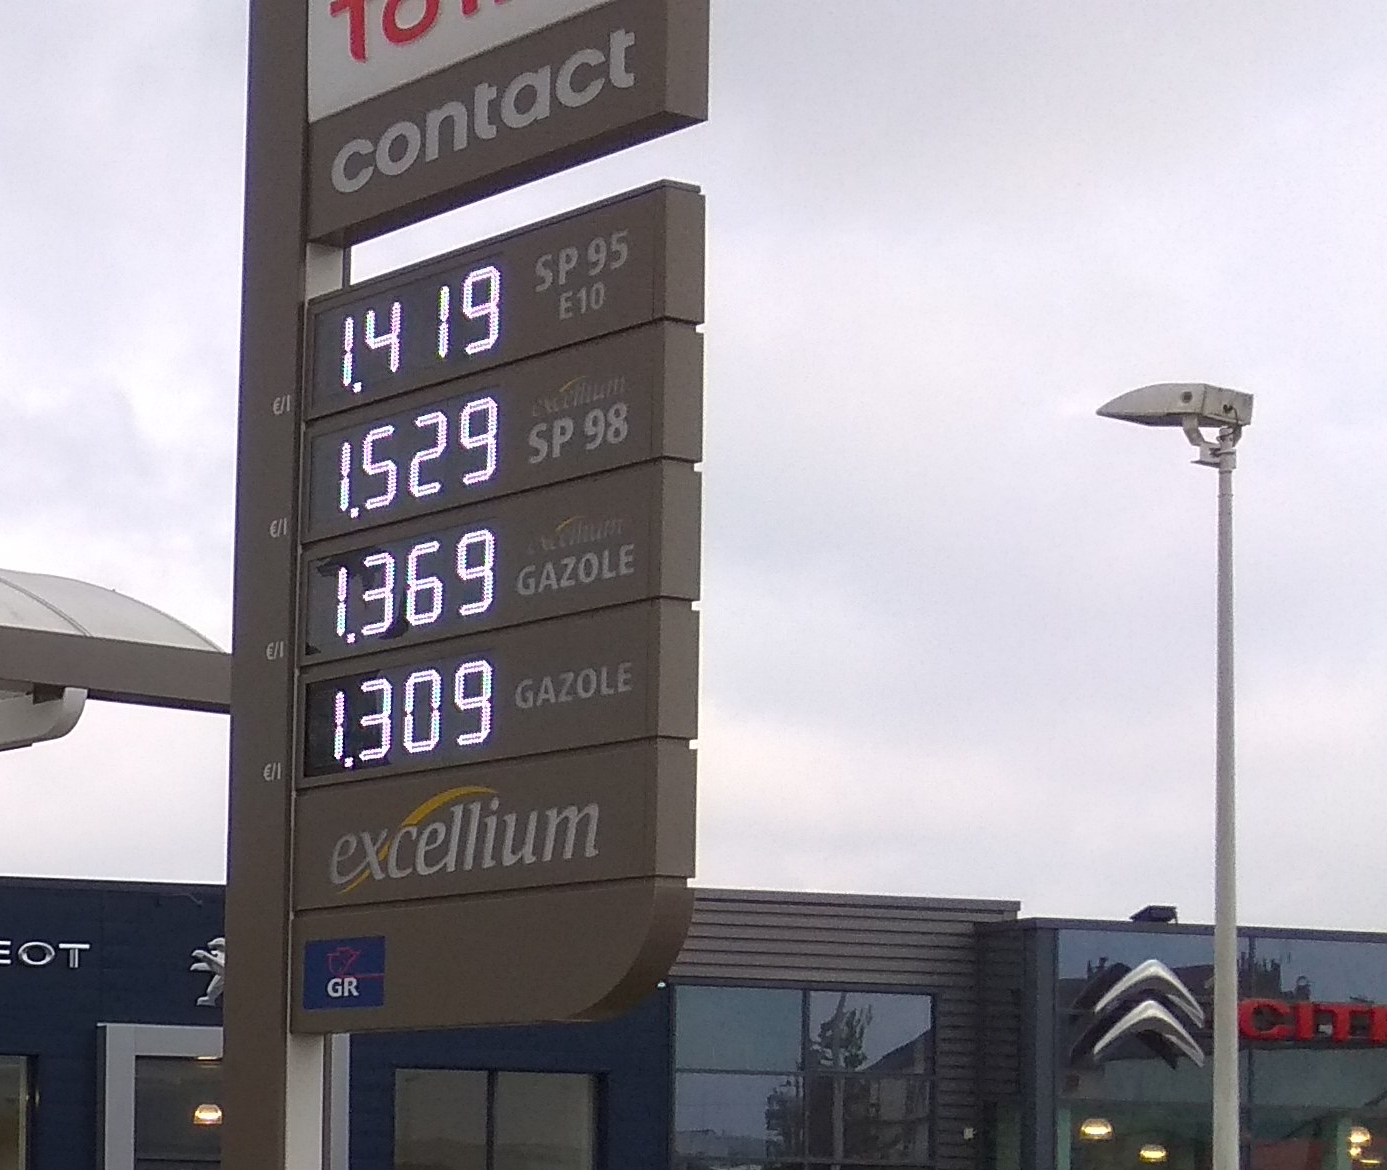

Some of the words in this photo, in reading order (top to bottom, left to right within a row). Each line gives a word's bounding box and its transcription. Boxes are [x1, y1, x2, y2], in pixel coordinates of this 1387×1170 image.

[331, 28, 635, 193] contact
[535, 246, 579, 292] SP
[587, 228, 628, 276] 95
[342, 266, 502, 393] 1.419
[559, 281, 605, 320] E10
[339, 396, 499, 518] 1.529
[529, 417, 574, 464] SP
[584, 402, 628, 450] 98
[335, 528, 495, 644] 1.369
[517, 544, 635, 596] GAZOLE
[333, 658, 493, 769] 1.309
[515, 662, 633, 710] GAZOLE
[329, 790, 600, 886] excellium
[327, 976, 359, 998] GR
